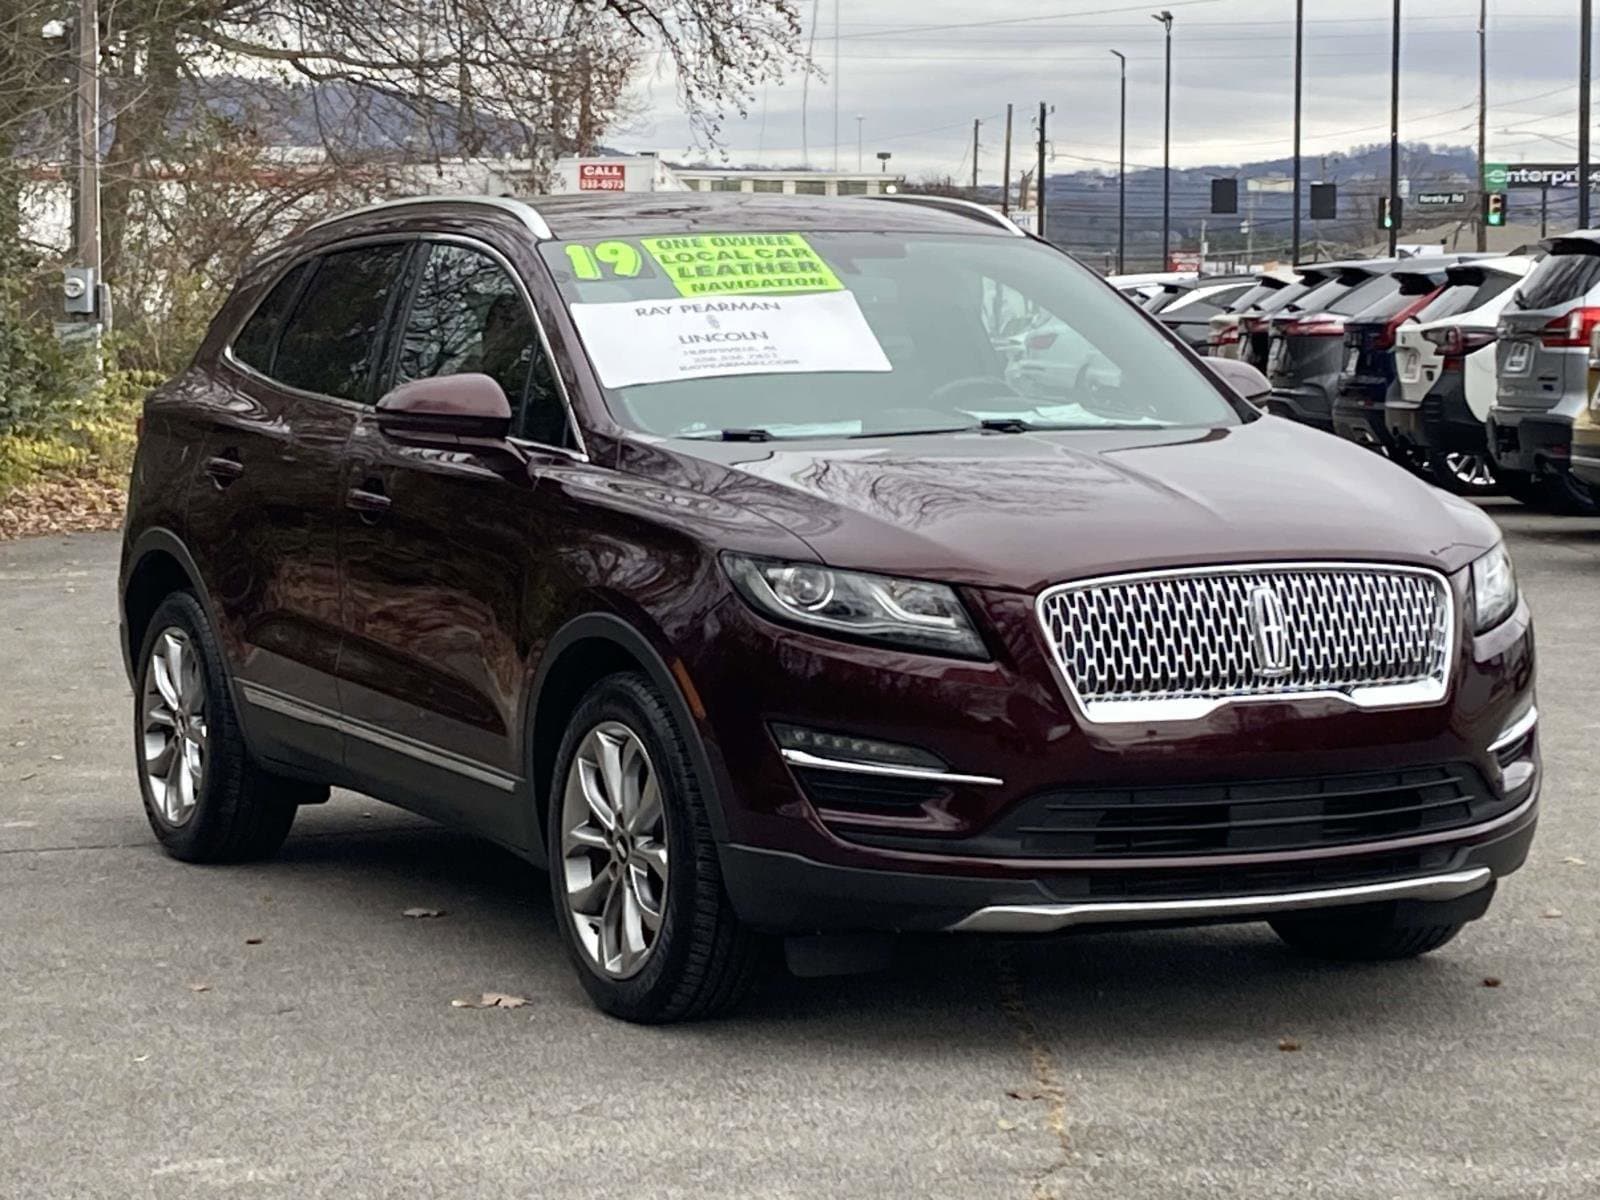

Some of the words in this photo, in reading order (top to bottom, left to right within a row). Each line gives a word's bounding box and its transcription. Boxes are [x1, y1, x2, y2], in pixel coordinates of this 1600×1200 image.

[583, 166, 621, 176] CALL
[656, 237, 704, 250] ONE
[710, 235, 796, 248] OWNER
[565, 240, 642, 281] 19
[660, 249, 750, 265] LOCAL
[754, 247, 812, 260] CAR
[678, 260, 822, 279] LEATHER
[691, 276, 829, 293] NAVIGATION
[635, 306, 672, 317] RAY
[680, 302, 782, 314] PEARMAN
[678, 330, 770, 345] LINCOLN
